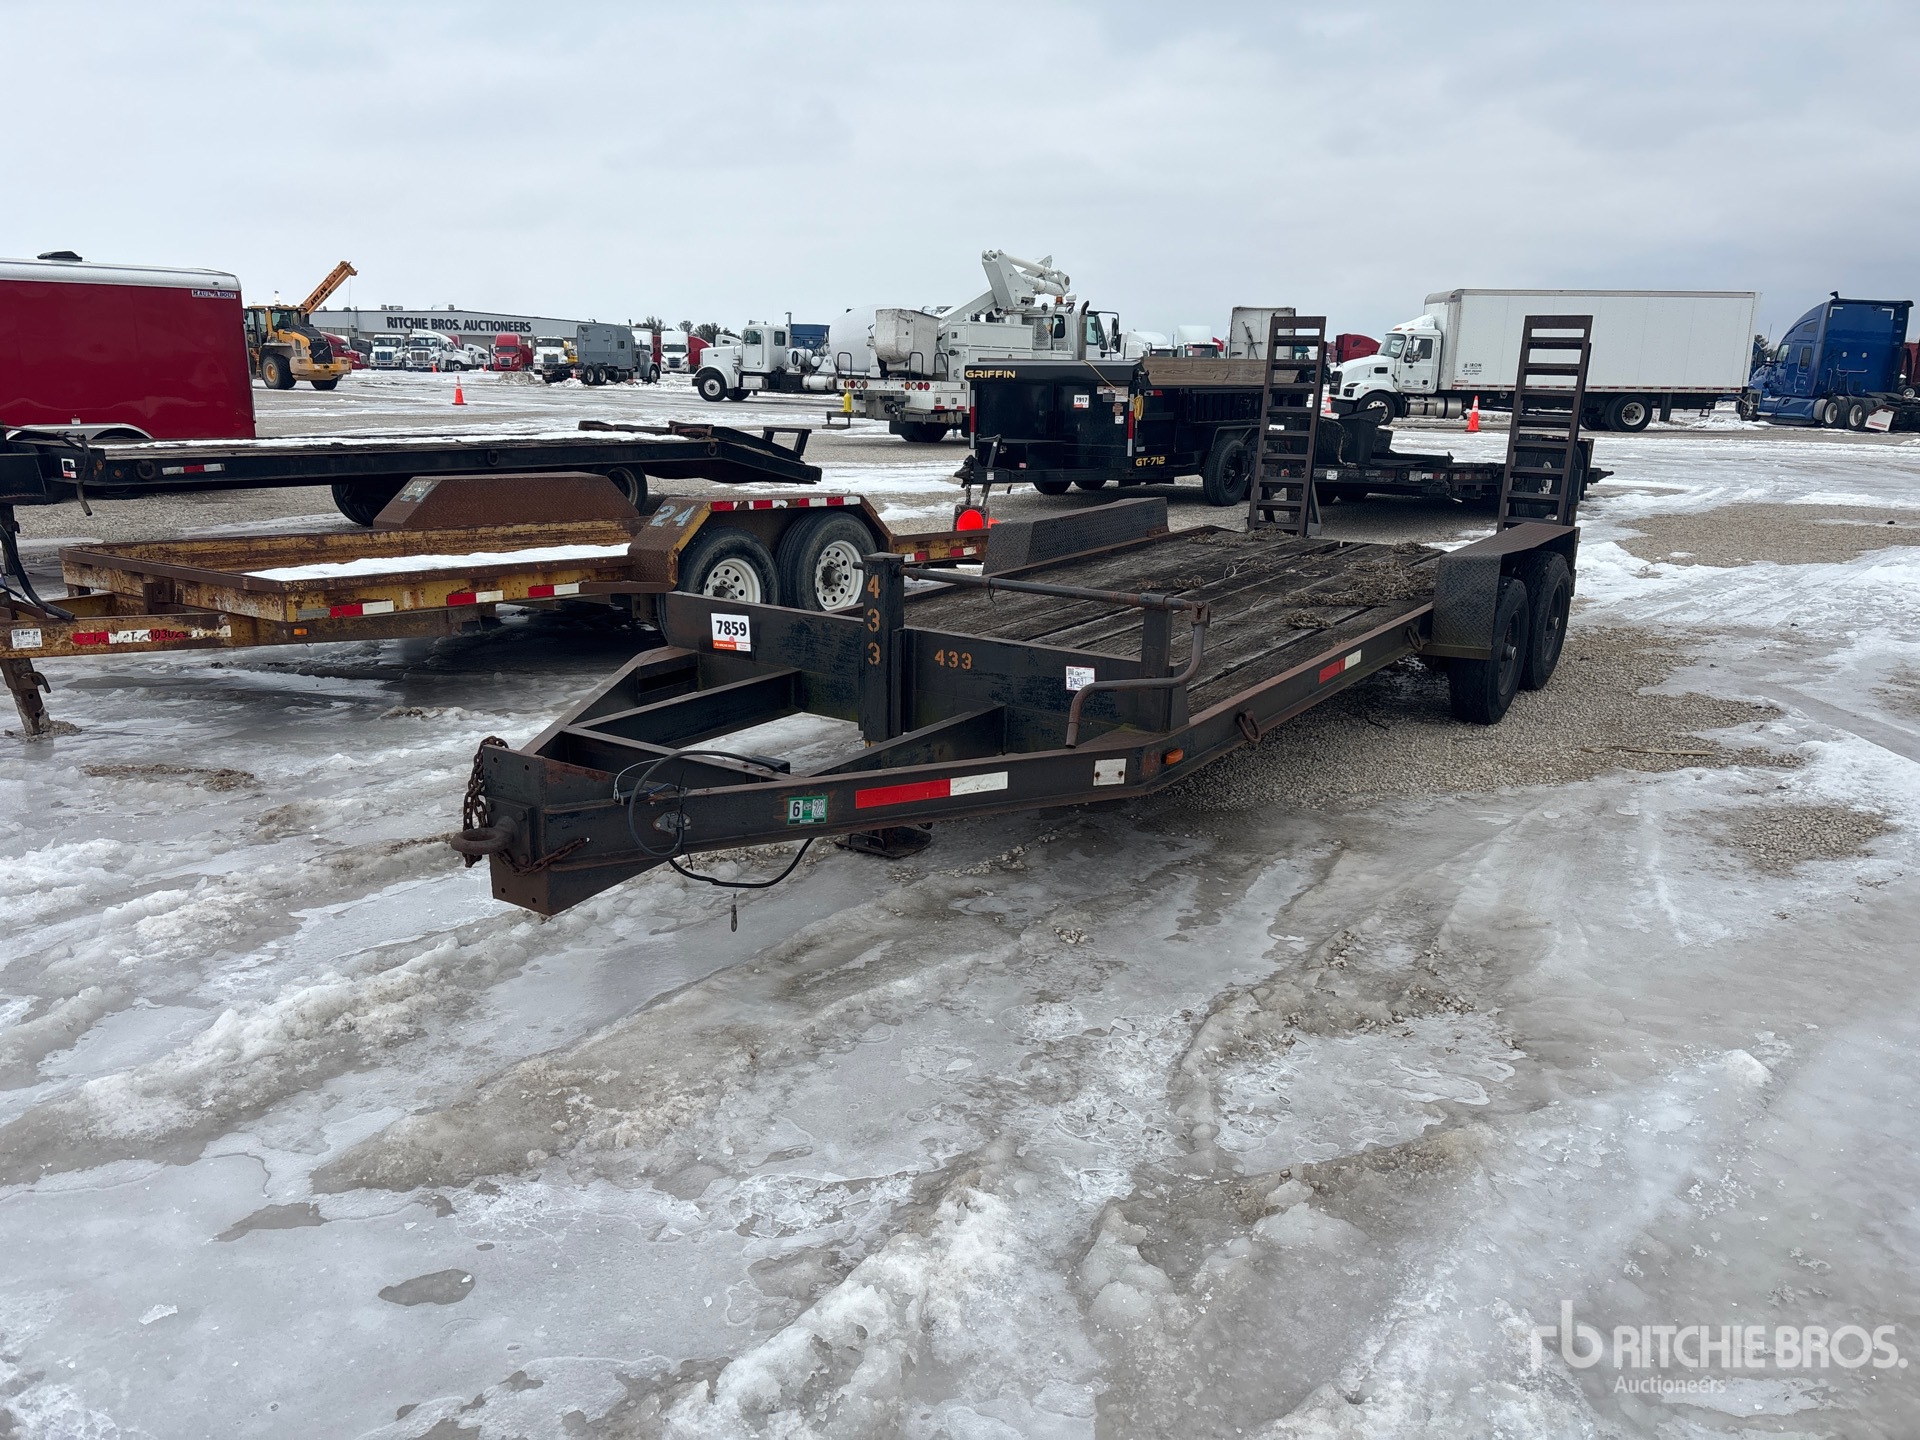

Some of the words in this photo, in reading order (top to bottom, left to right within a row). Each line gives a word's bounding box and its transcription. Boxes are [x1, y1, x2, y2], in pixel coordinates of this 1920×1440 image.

[386, 316, 429, 330] RITCHIE
[431, 318, 462, 331] BROS.
[463, 319, 532, 333] AUCTIONEERS
[965, 369, 1017, 379] GRIFFIN
[1135, 456, 1166, 467] GT-712
[650, 504, 696, 527] 24
[715, 620, 748, 637] 7859
[934, 649, 973, 671] 433
[792, 801, 801, 818] 6
